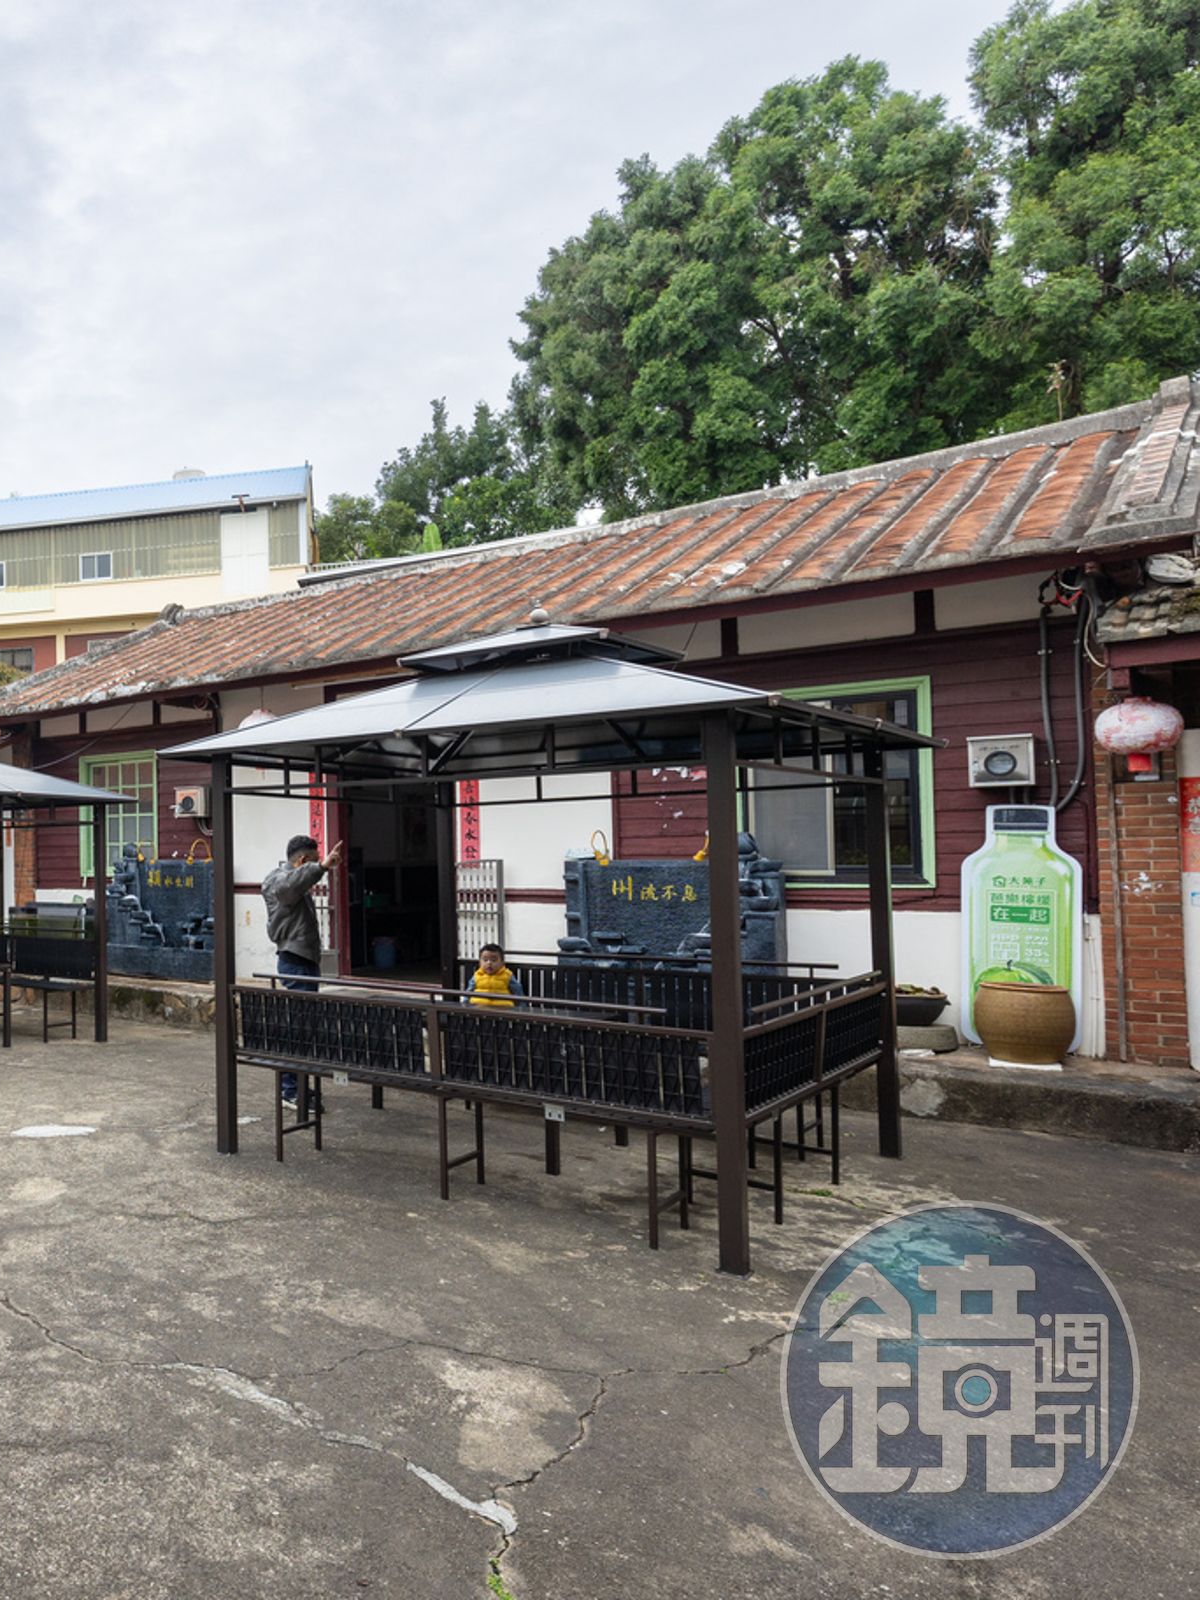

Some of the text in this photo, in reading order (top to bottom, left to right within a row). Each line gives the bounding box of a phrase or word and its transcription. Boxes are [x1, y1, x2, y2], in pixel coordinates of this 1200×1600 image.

[612, 875, 697, 902] 川流不息
[992, 906, 1049, 922] 在一起
